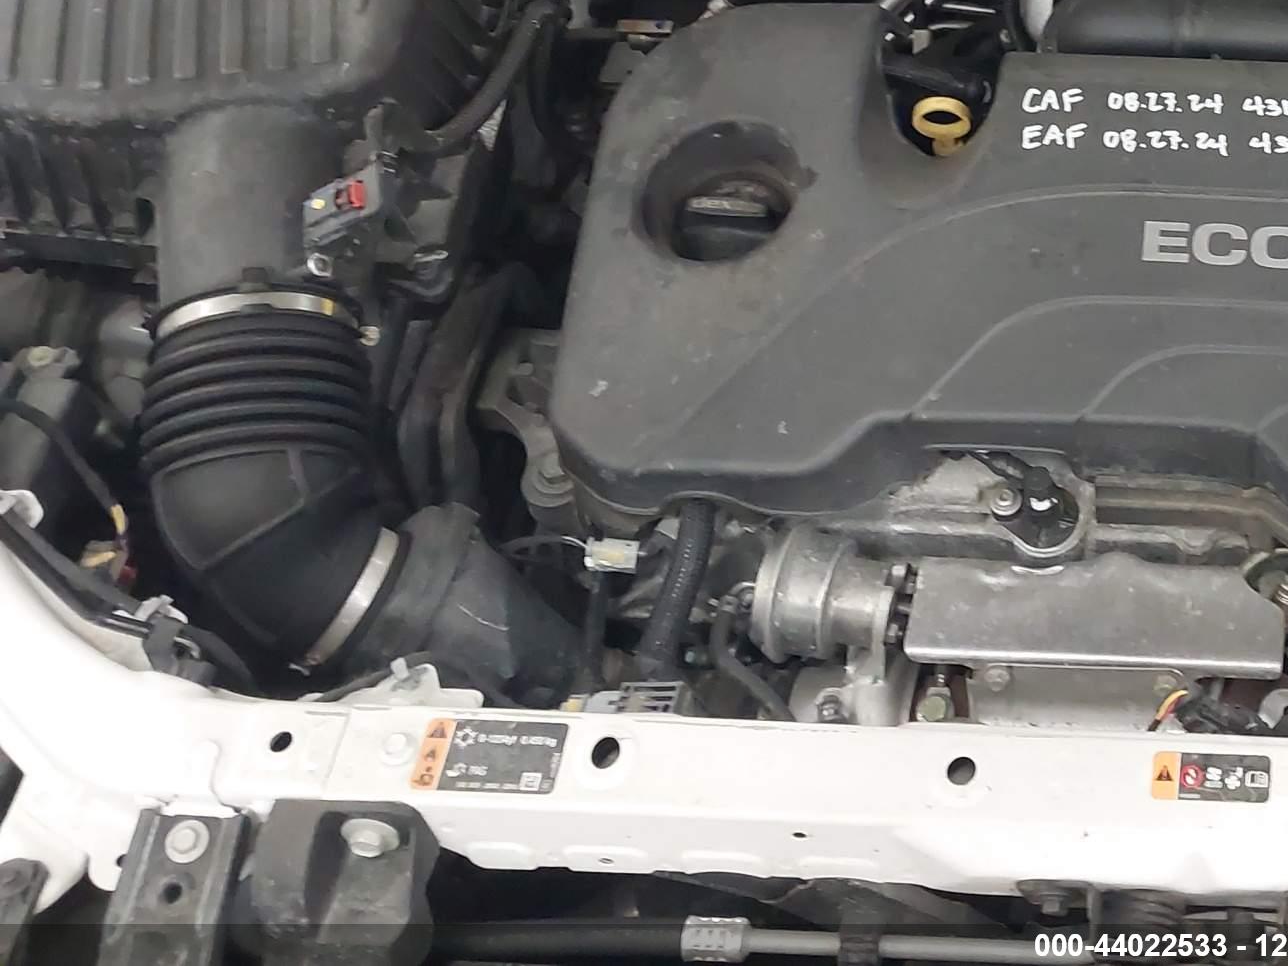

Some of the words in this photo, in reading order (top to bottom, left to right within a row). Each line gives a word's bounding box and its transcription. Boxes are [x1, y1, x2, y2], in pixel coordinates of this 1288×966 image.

[1021, 87, 1085, 114] CAF
[1107, 91, 1225, 115] 08.27.24
[1021, 122, 1089, 151] EAF
[1102, 128, 1230, 157] 08.27.24
